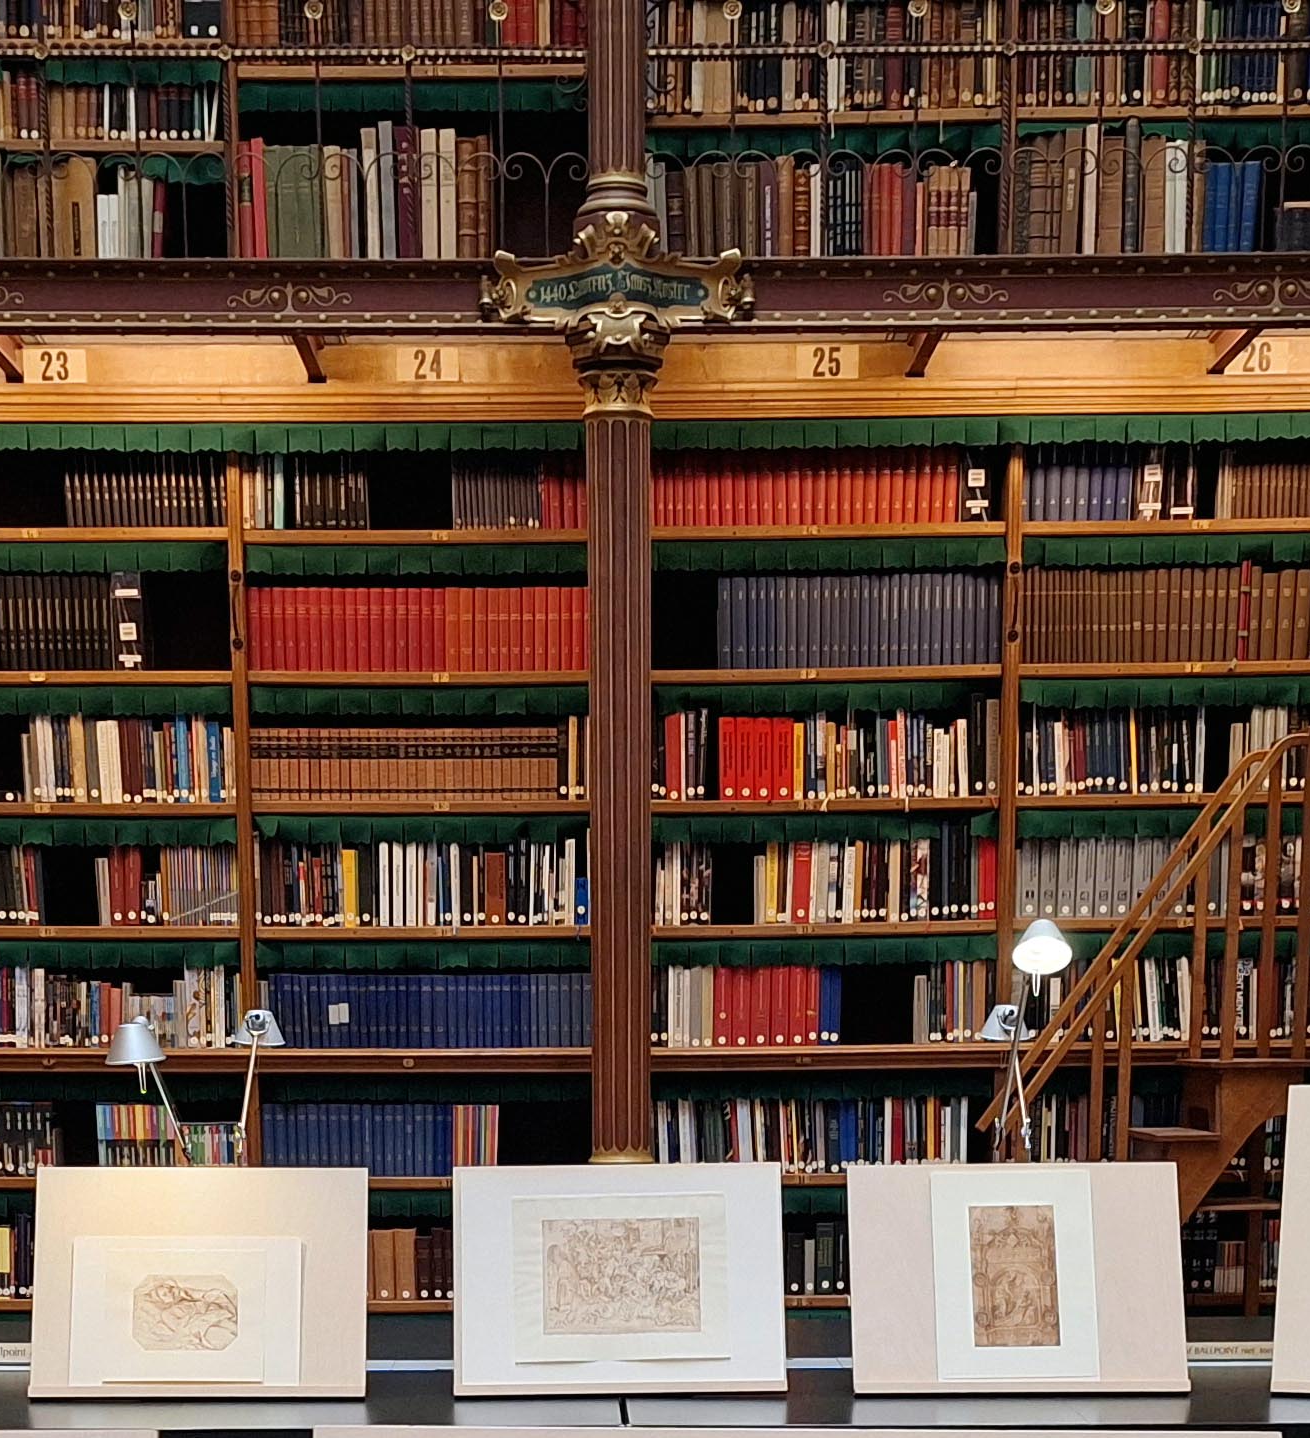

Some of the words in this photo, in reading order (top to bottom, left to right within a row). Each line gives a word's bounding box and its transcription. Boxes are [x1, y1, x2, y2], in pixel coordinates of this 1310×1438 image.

[541, 285, 566, 303] 1440
[40, 351, 69, 381] 23
[413, 349, 442, 380] 24
[812, 347, 841, 378] 25
[1242, 341, 1271, 373] 26
[1194, 1346, 1238, 1355] BALLPOINT
